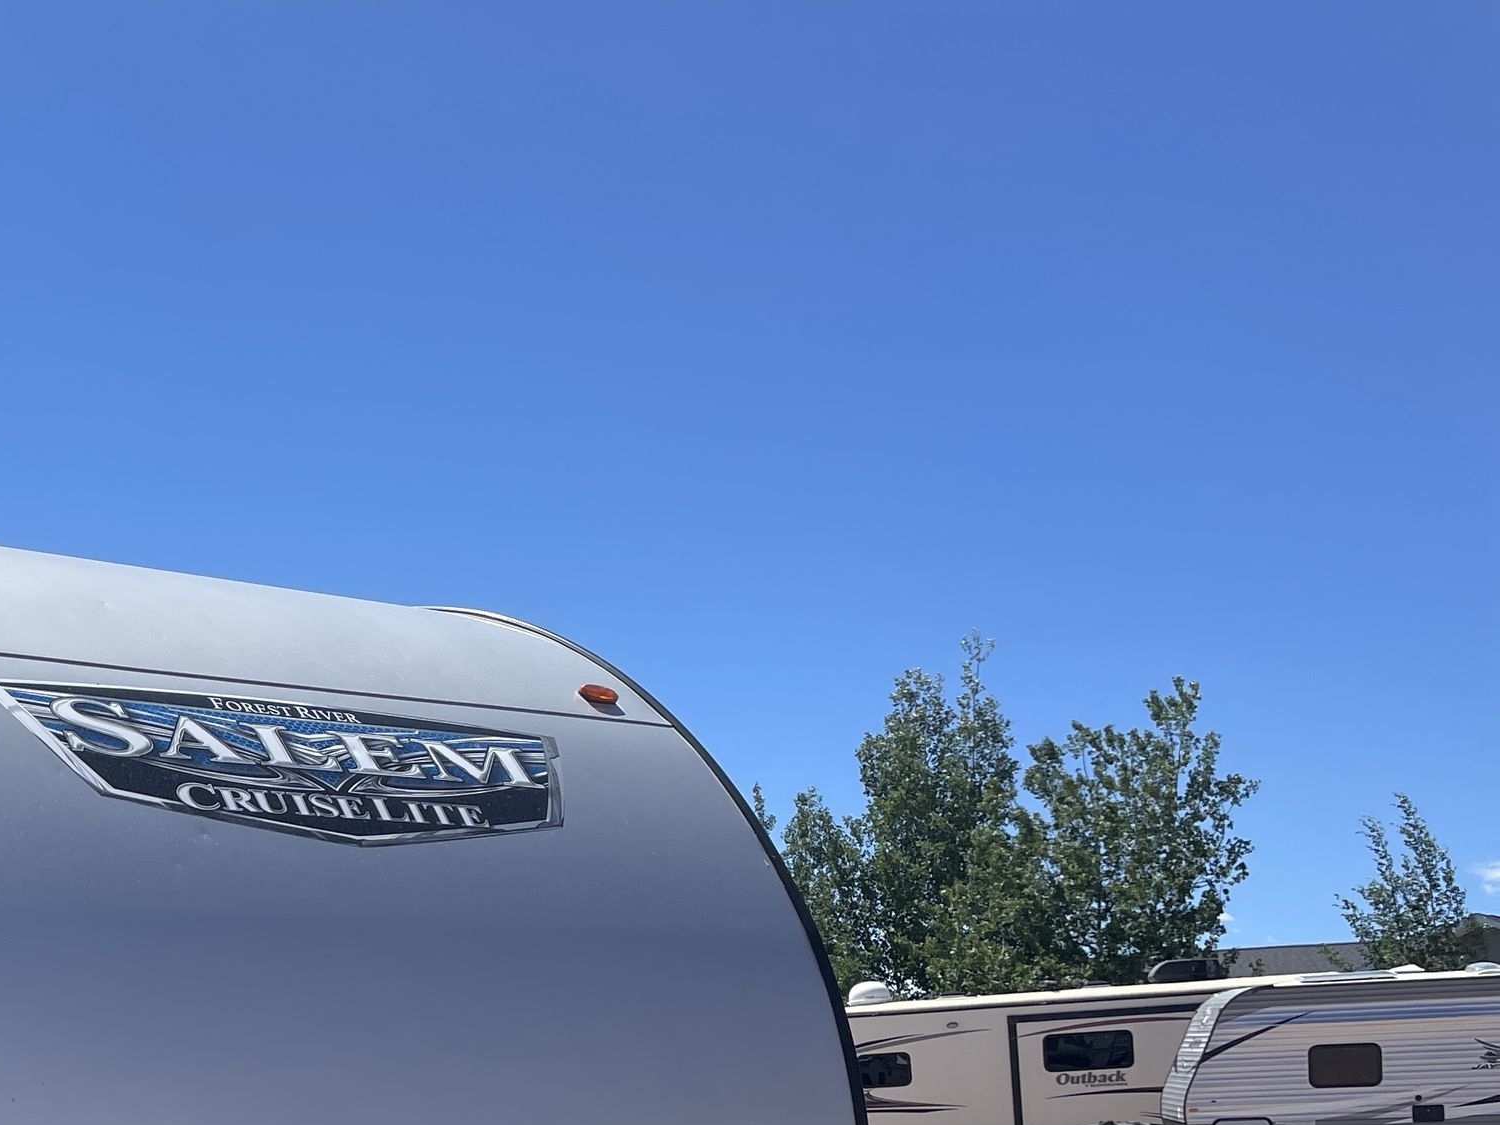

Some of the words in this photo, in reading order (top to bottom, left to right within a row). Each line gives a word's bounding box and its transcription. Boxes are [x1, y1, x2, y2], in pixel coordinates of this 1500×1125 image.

[208, 696, 292, 717] FOREST
[296, 705, 361, 724] RIVER
[49, 696, 546, 790] SALEM
[1056, 1070, 1127, 1086] Outback
